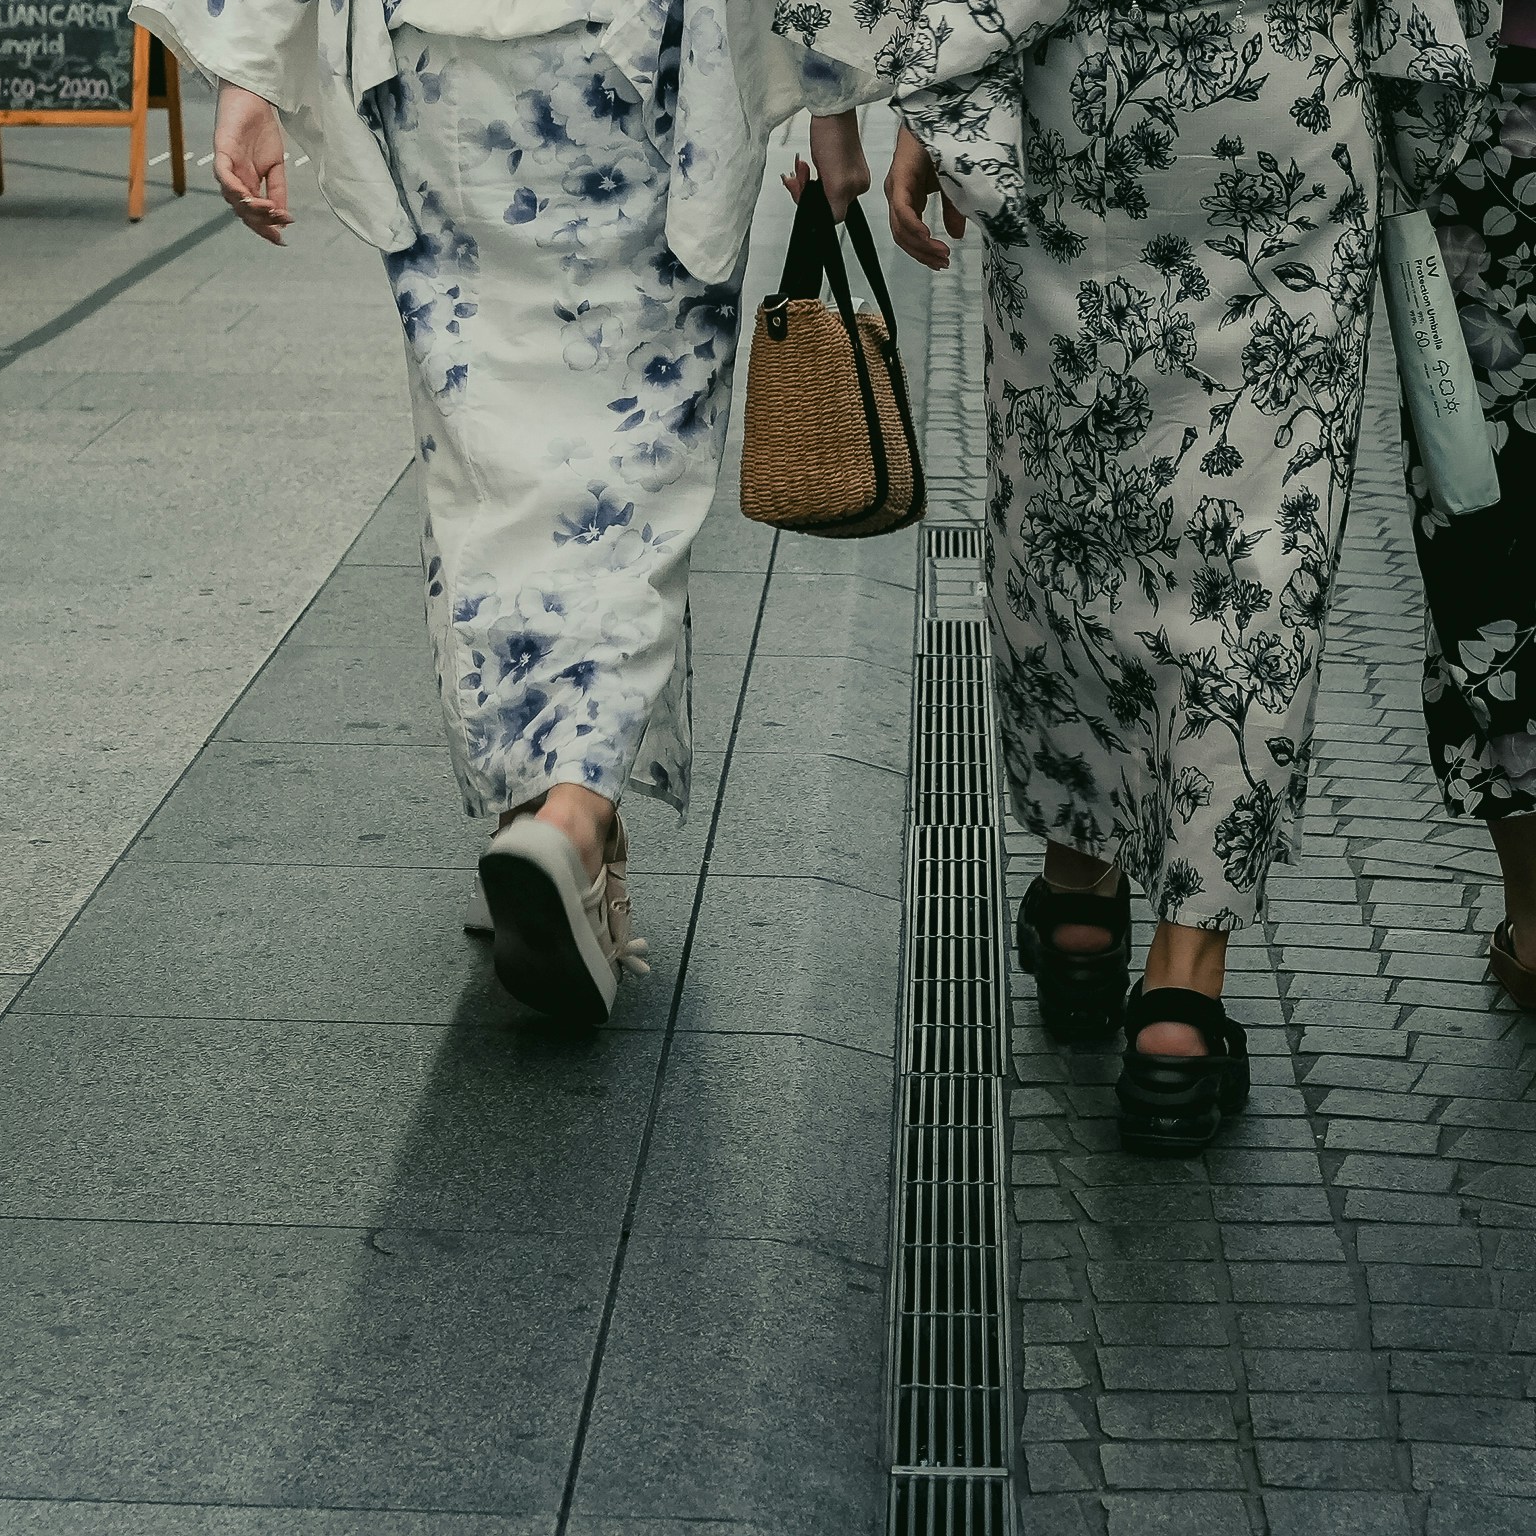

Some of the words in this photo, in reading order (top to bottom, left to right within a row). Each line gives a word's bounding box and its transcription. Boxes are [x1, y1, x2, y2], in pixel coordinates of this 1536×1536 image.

[1425, 255, 1440, 278] UV
[1414, 259, 1432, 307] Protection
[1427, 308, 1444, 351] Umbrella
[1414, 330, 1431, 348] 60
